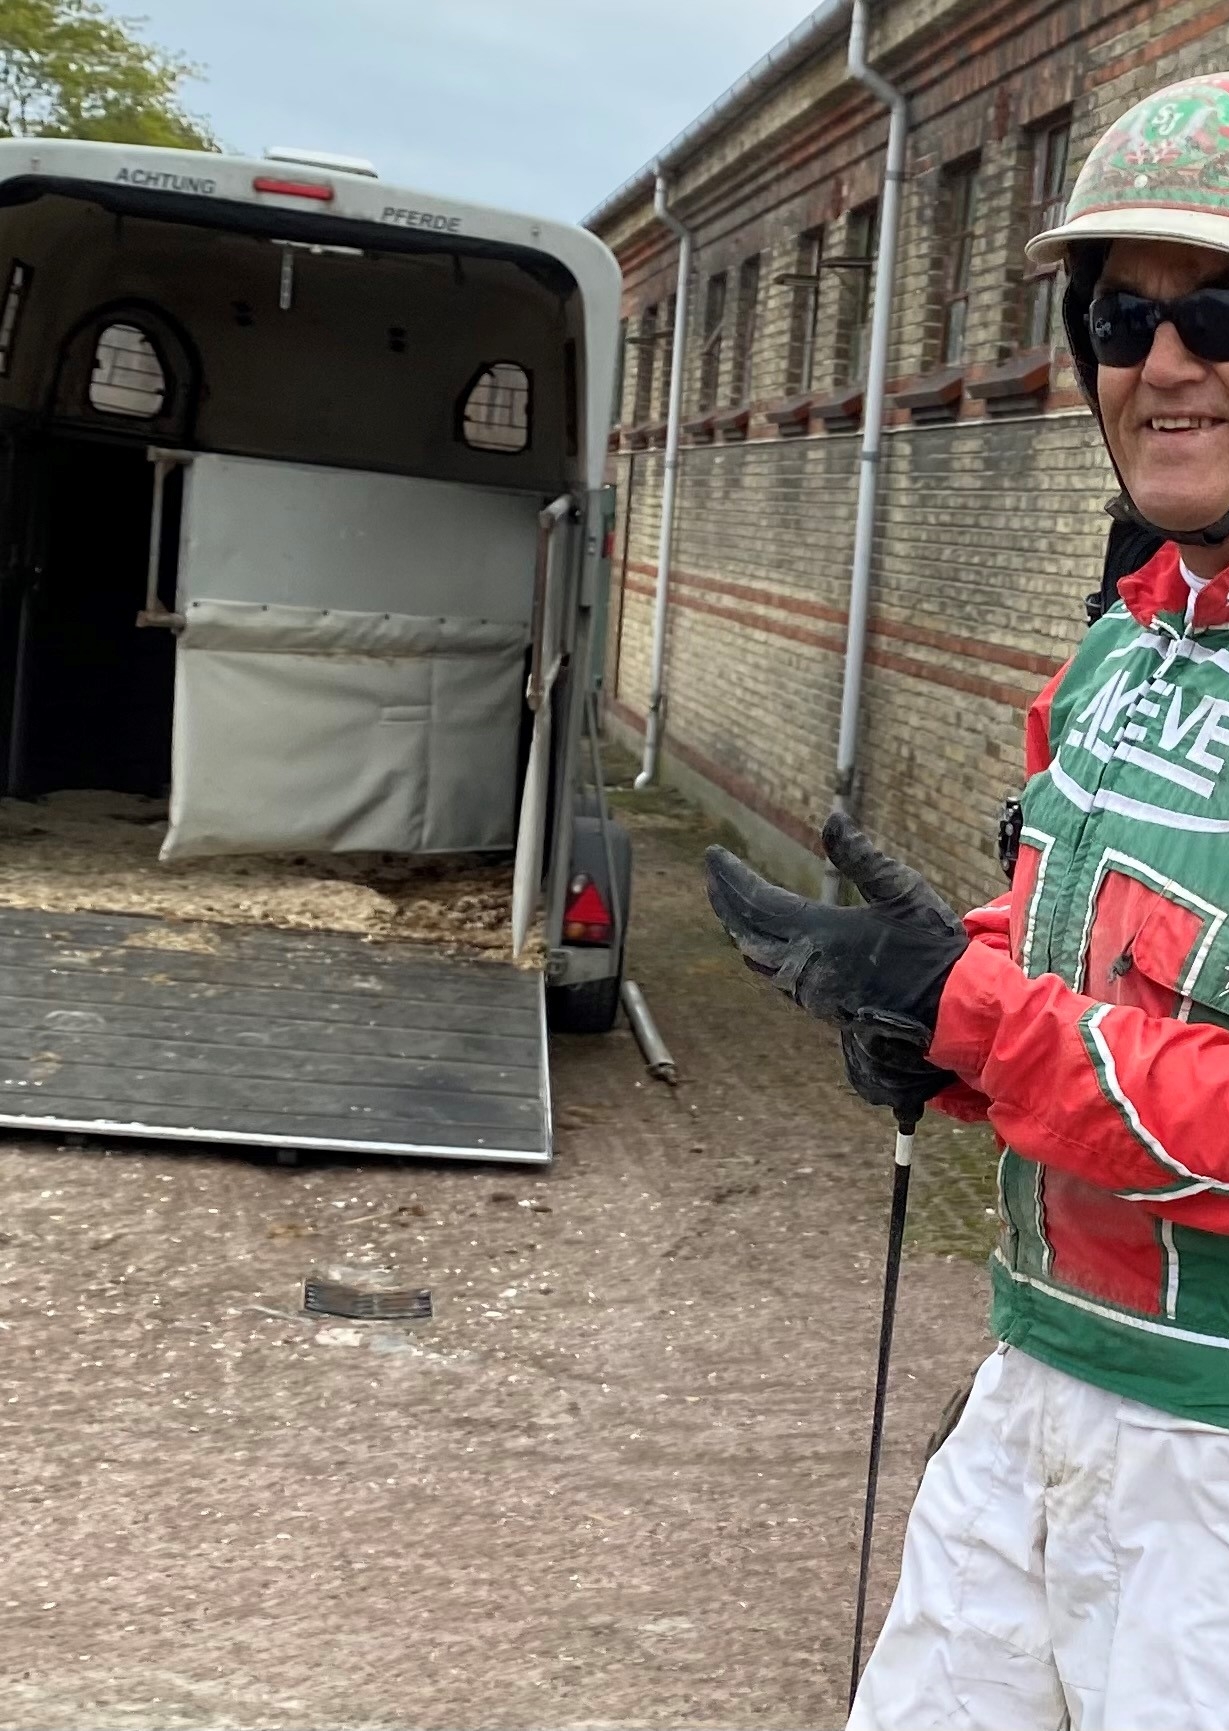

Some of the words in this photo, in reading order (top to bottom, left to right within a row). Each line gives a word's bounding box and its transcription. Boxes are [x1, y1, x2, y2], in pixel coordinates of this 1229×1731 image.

[1151, 103, 1184, 136] SJ
[115, 168, 217, 195] ACHTUNG
[382, 207, 462, 233] PFERDE
